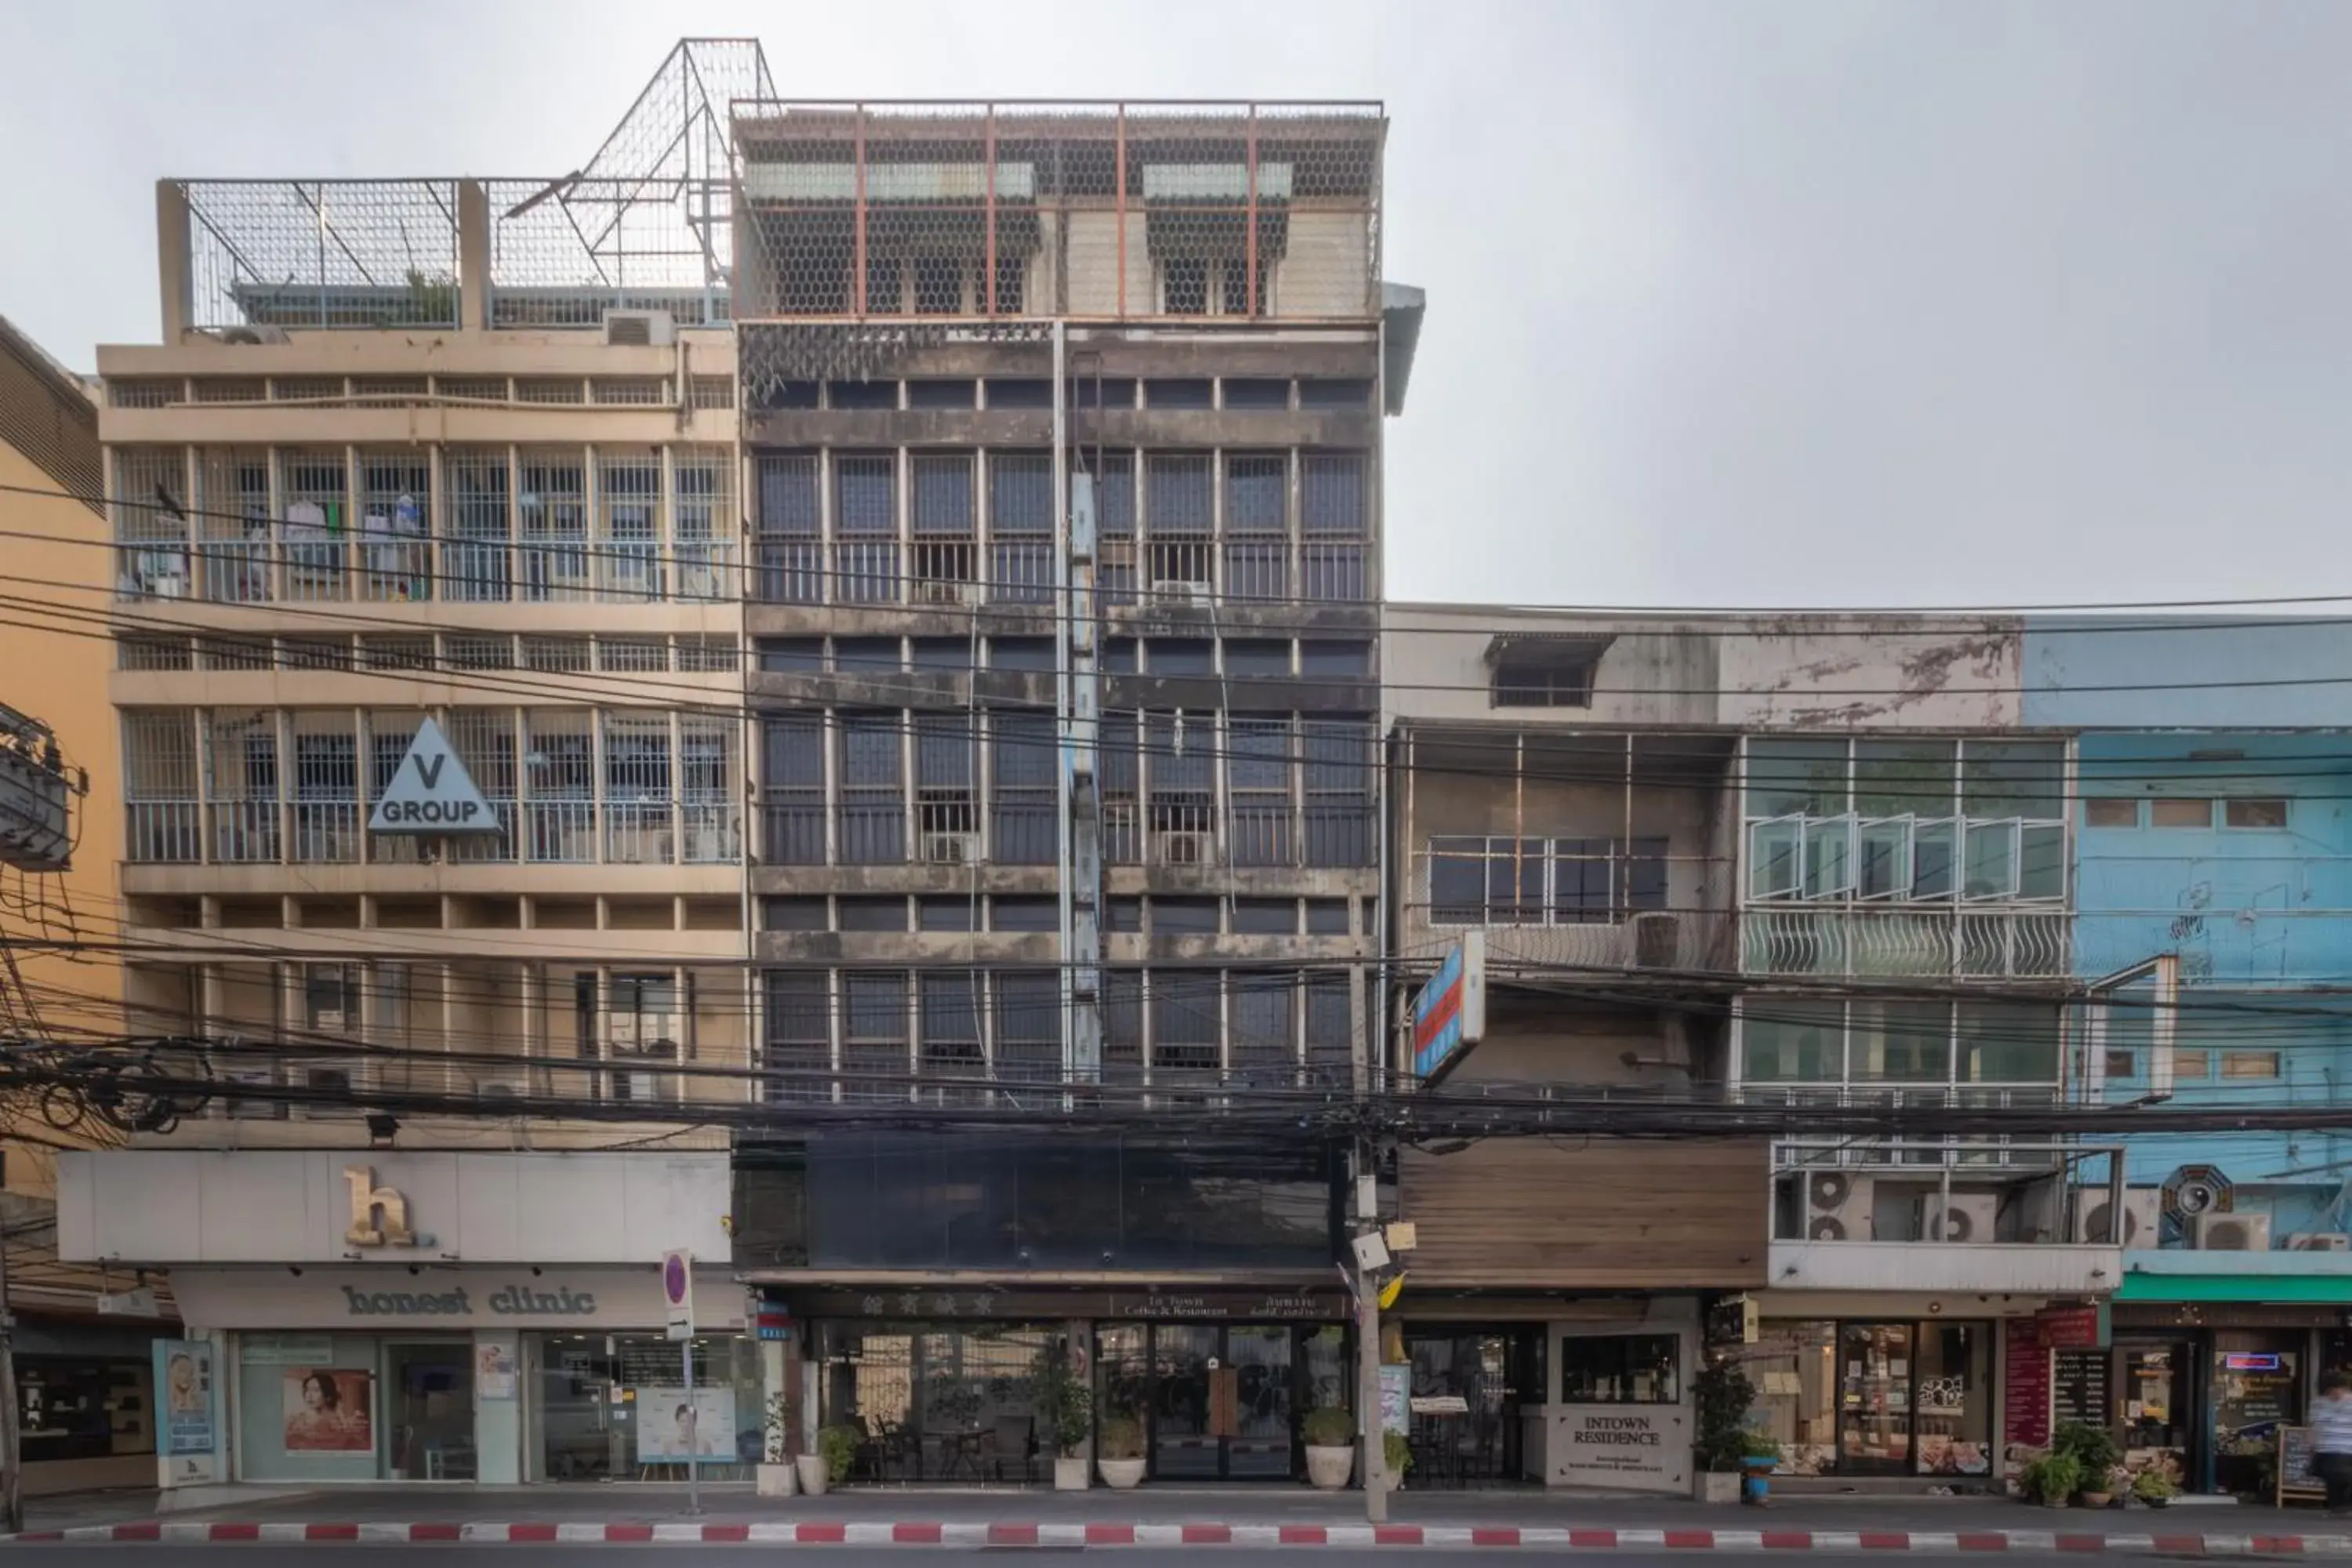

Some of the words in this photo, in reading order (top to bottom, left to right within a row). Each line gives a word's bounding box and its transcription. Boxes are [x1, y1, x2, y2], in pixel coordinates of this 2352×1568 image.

[412, 753, 446, 789] V
[383, 800, 479, 823] GROUP
[340, 1285, 473, 1316] honest
[488, 1283, 598, 1316] clinic
[1584, 1417, 1650, 1430] INTOWN
[1574, 1431, 1661, 1446] RESIDENCE
